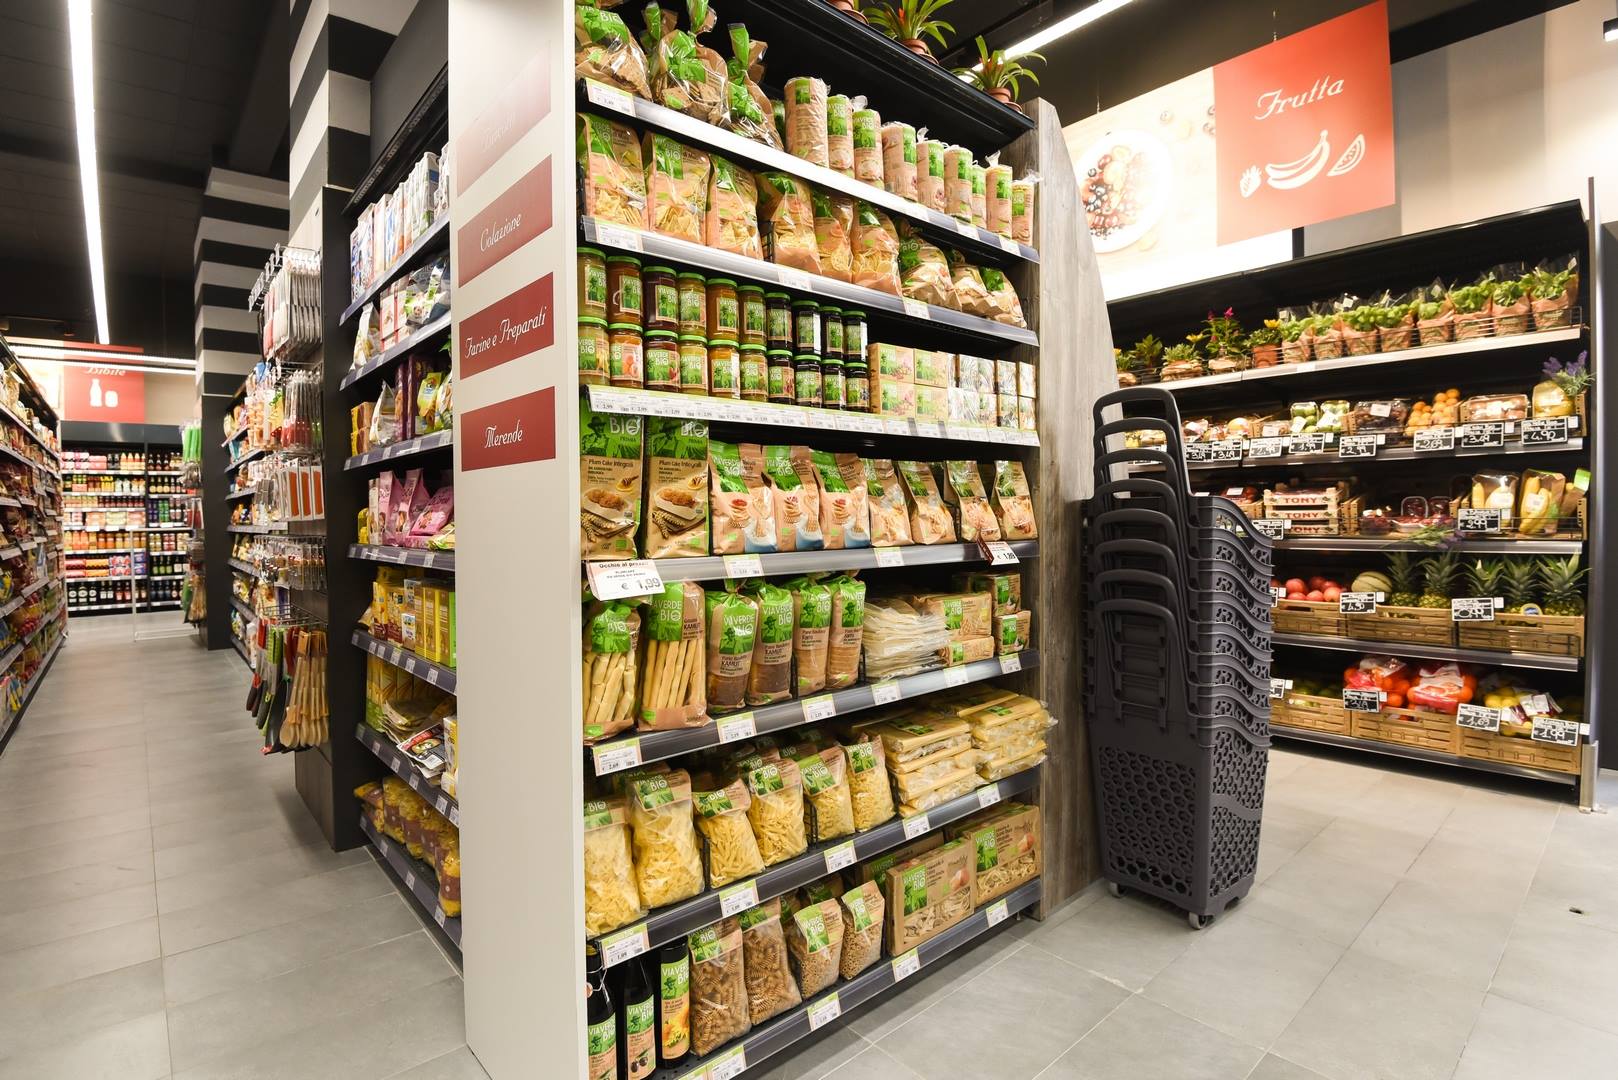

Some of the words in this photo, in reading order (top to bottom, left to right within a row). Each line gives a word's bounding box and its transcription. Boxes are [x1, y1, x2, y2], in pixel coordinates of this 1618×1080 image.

[1254, 75, 1345, 121] Frutta
[480, 213, 522, 252] Colazione
[465, 335, 491, 360] Farine
[491, 333, 498, 345] e
[498, 305, 548, 345] Preparati
[655, 356, 669, 366] BIO
[610, 416, 641, 436] BIO
[484, 418, 524, 449] Merende
[777, 466, 794, 476] BIO
[621, 582, 629, 590] €
[638, 577, 661, 590] 1,99
[660, 610, 681, 622] BIO
[762, 603, 793, 616] VIAVERDE
[778, 612, 792, 626] BIO
[607, 621, 626, 633] BIO
[683, 623, 701, 631] KAMUT
[860, 746, 873, 758] BIO
[762, 766, 779, 779] BIO
[812, 766, 829, 779] BIO
[650, 779, 668, 792] BIO
[588, 800, 607, 812] BIO
[984, 838, 996, 849] BIO
[913, 877, 926, 891] BIO
[700, 930, 716, 944] BIO
